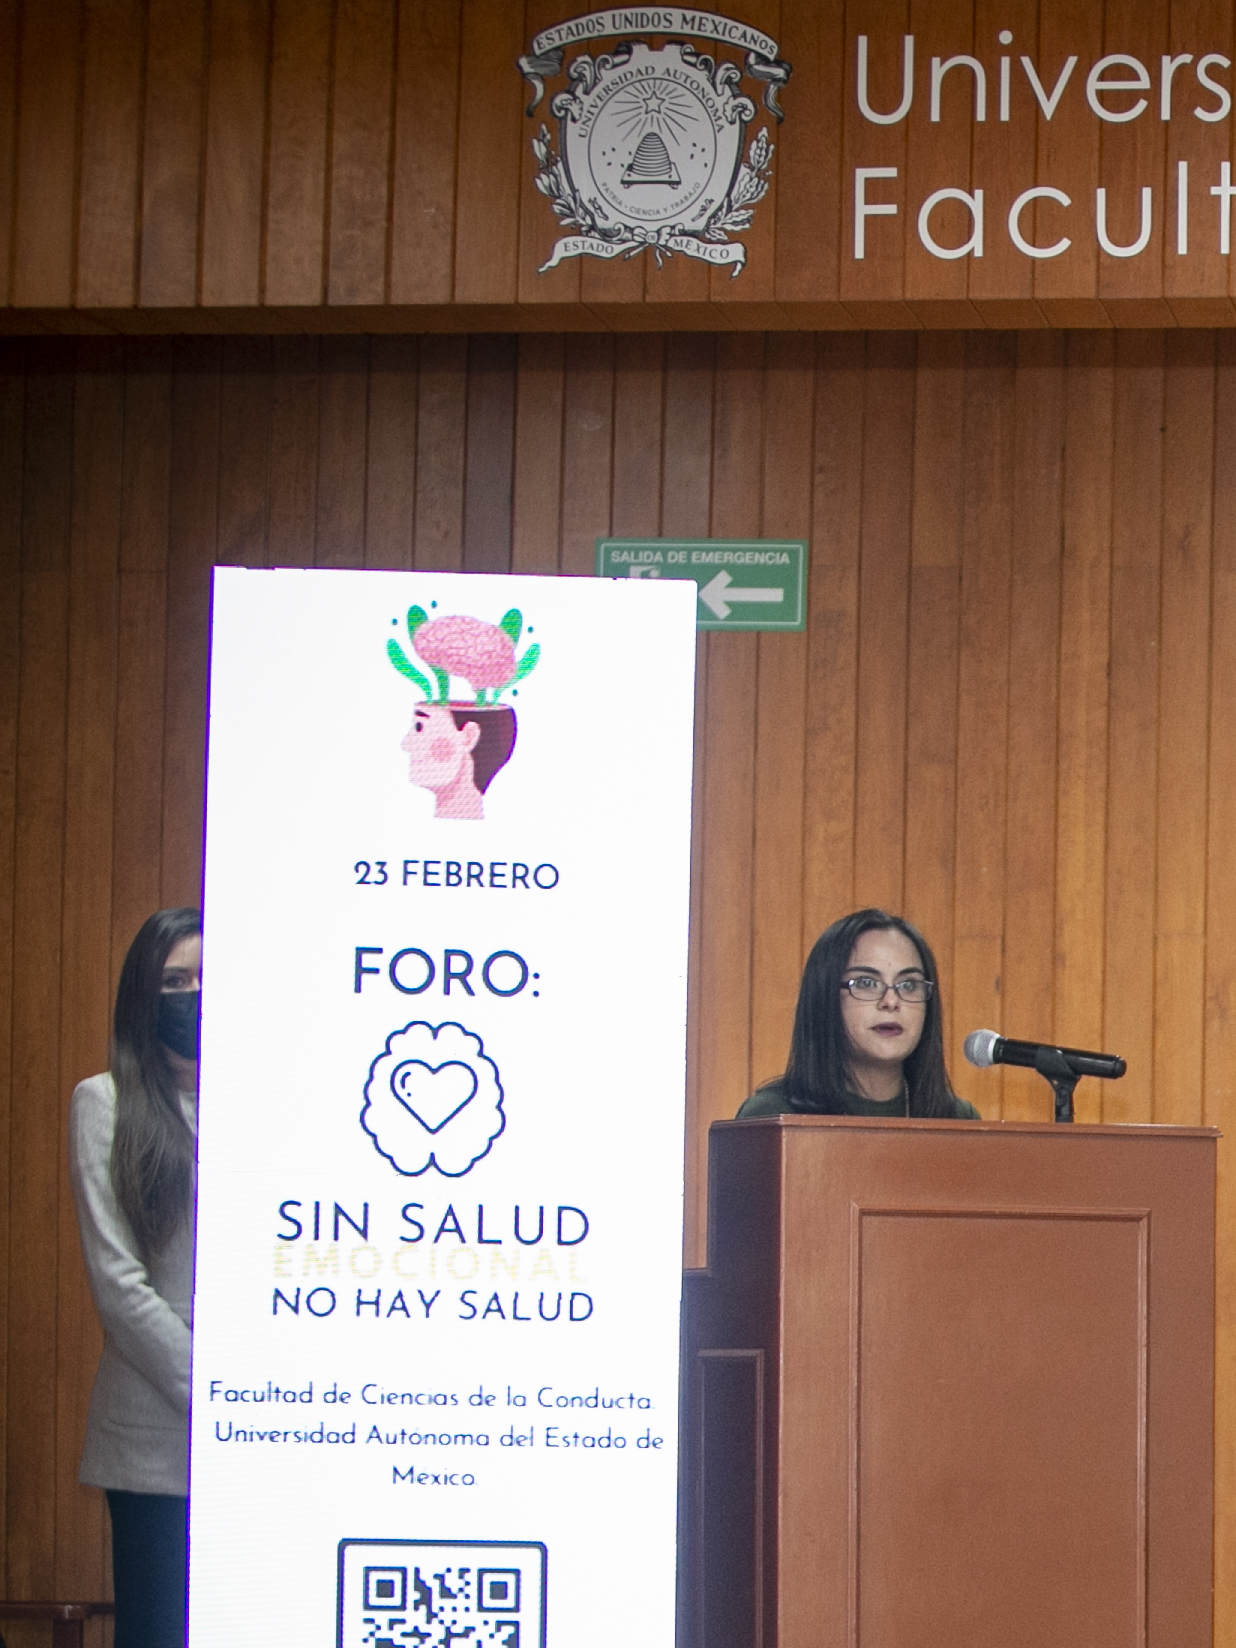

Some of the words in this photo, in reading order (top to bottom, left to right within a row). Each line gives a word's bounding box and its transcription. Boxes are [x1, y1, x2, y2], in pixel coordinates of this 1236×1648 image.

[535, 16, 605, 50] ESTADOS
[611, 12, 673, 31] UNIDOS
[680, 13, 776, 56] MEXICANOS
[578, 65, 655, 139] UNIVERSIDAD
[662, 66, 725, 134] AUTONOMA
[601, 182, 623, 207] PATRIA
[629, 205, 661, 217] CIENCIA
[670, 182, 701, 211] TRABAJO
[563, 241, 615, 255] ESTADO
[673, 237, 731, 259] MEXICO
[611, 550, 664, 563] SALIDA
[667, 550, 687, 563] DE
[691, 551, 790, 565] EMERGENCIA
[354, 861, 388, 886] 23
[402, 859, 560, 890] FEBRERO
[354, 946, 541, 998] FORO:
[277, 1200, 369, 1242] SIN
[399, 1203, 590, 1246] SALUD
[272, 1243, 588, 1283] EMOCIONAL
[273, 1287, 337, 1318] NO
[356, 1288, 441, 1319] HAY
[459, 1290, 594, 1322] SALUD
[210, 1380, 313, 1404] Facultad
[323, 1382, 352, 1404] de
[361, 1384, 459, 1406] Ciencias
[468, 1385, 496, 1406] de
[507, 1385, 527, 1407] la
[215, 1421, 356, 1444] Universidad
[500, 1425, 534, 1447] del
[545, 1427, 627, 1449] Estado
[636, 1428, 664, 1449] de
